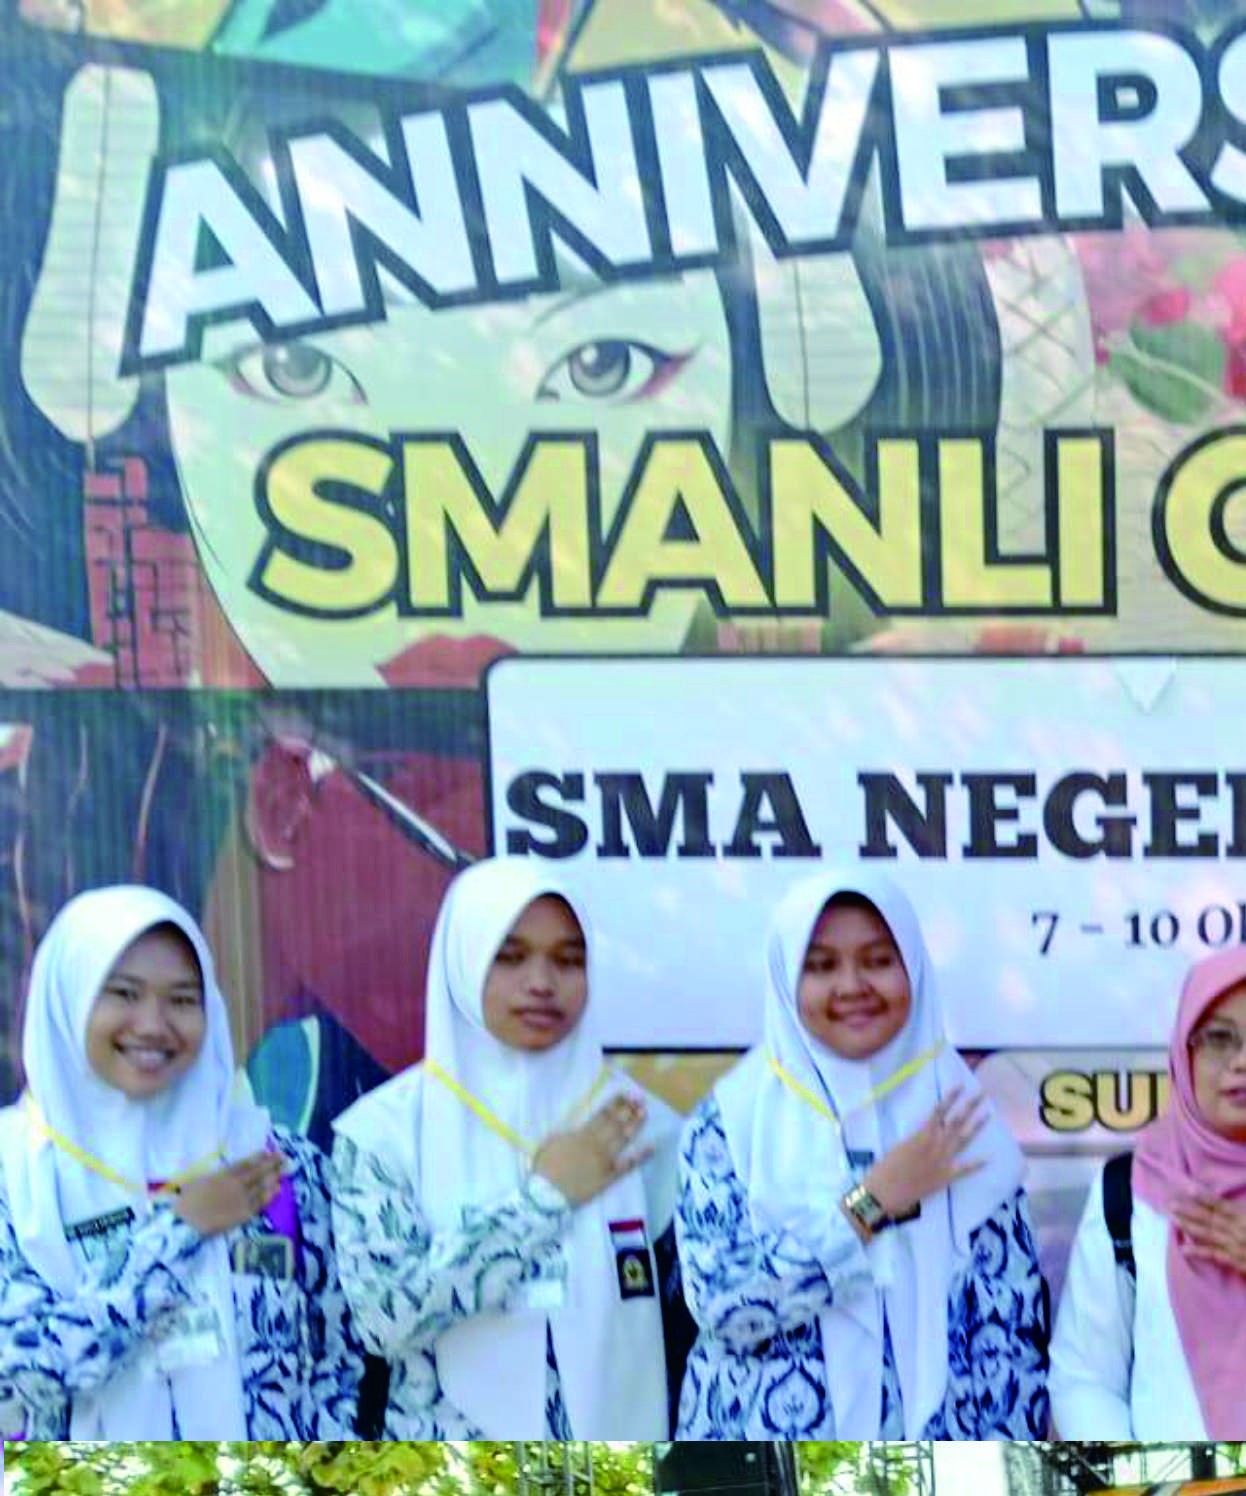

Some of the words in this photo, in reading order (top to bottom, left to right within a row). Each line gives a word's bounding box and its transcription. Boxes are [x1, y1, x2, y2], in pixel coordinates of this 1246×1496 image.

[250, 426, 1117, 619] SMANLI
[506, 770, 820, 858] SMA
[1030, 911, 1060, 955] 7
[1124, 908, 1180, 948] 10
